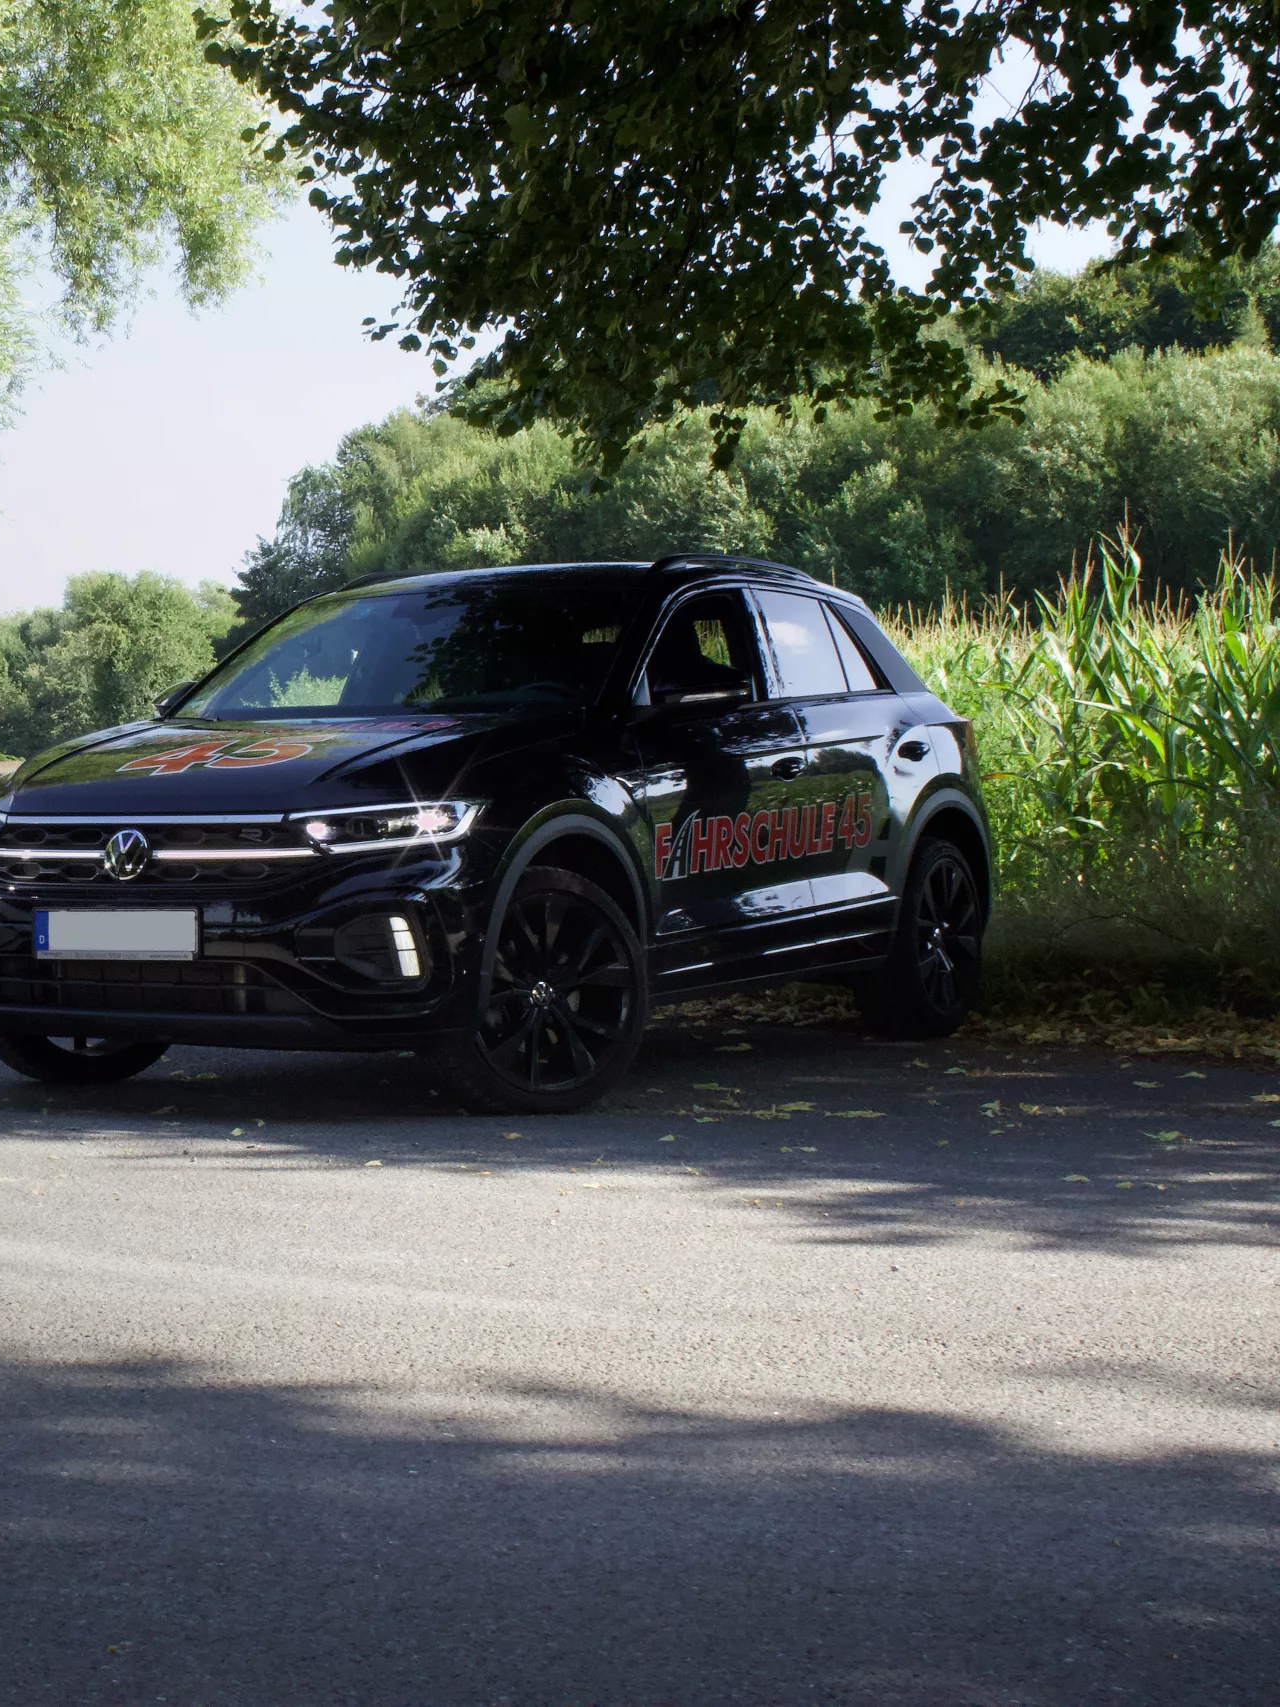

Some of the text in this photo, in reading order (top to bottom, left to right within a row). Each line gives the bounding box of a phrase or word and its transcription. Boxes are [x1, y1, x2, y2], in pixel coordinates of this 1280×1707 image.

[115, 732, 346, 777] 45
[655, 791, 871, 881] FAHRSCHULE 45
